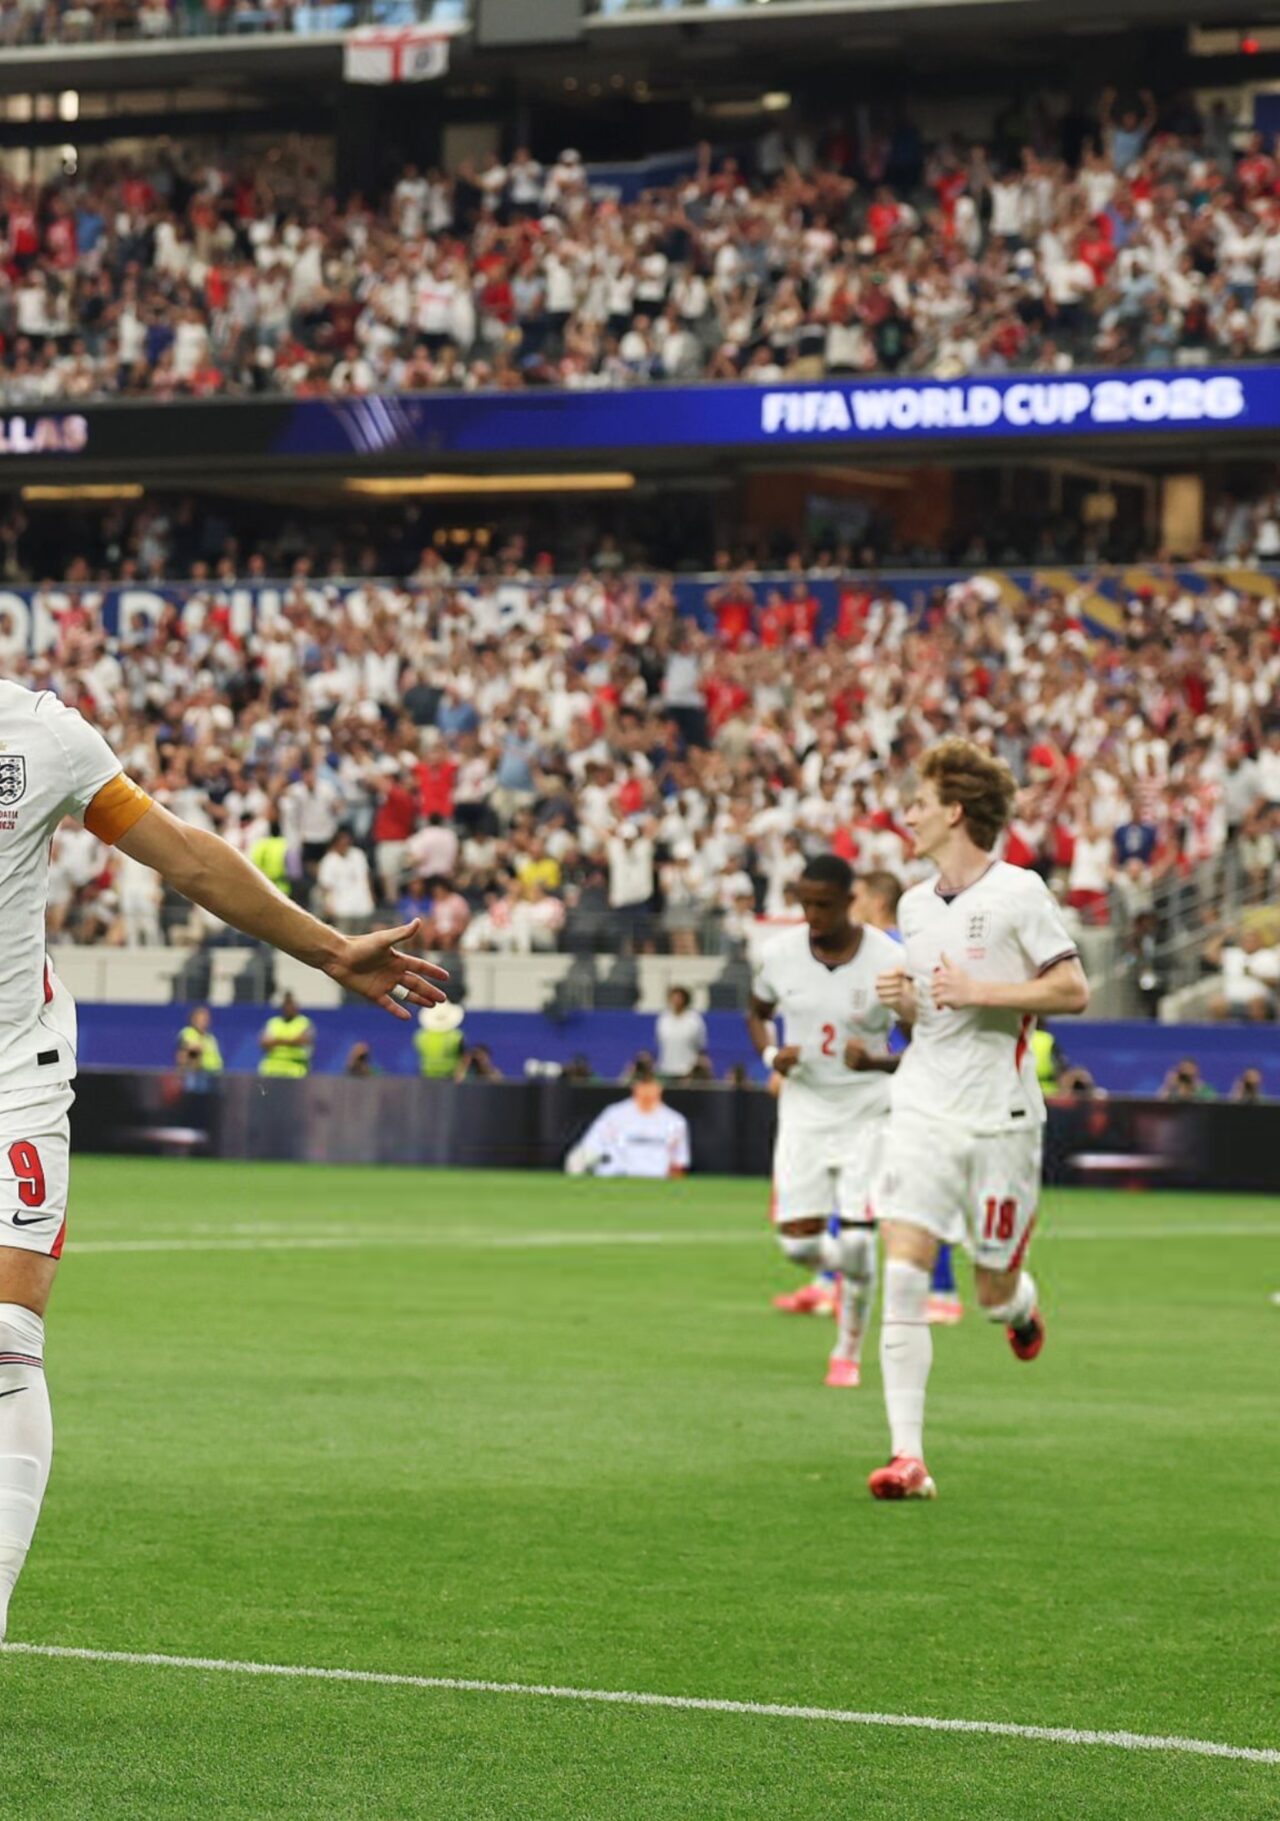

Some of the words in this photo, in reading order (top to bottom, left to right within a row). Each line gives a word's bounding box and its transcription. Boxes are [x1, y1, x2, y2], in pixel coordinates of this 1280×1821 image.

[761, 392, 850, 433] FIFA
[852, 386, 1002, 430] WORLD
[1004, 382, 1090, 425] CUP
[1092, 377, 1244, 422] 2026
[821, 1024, 837, 1056] 2
[8, 1140, 46, 1208] 9
